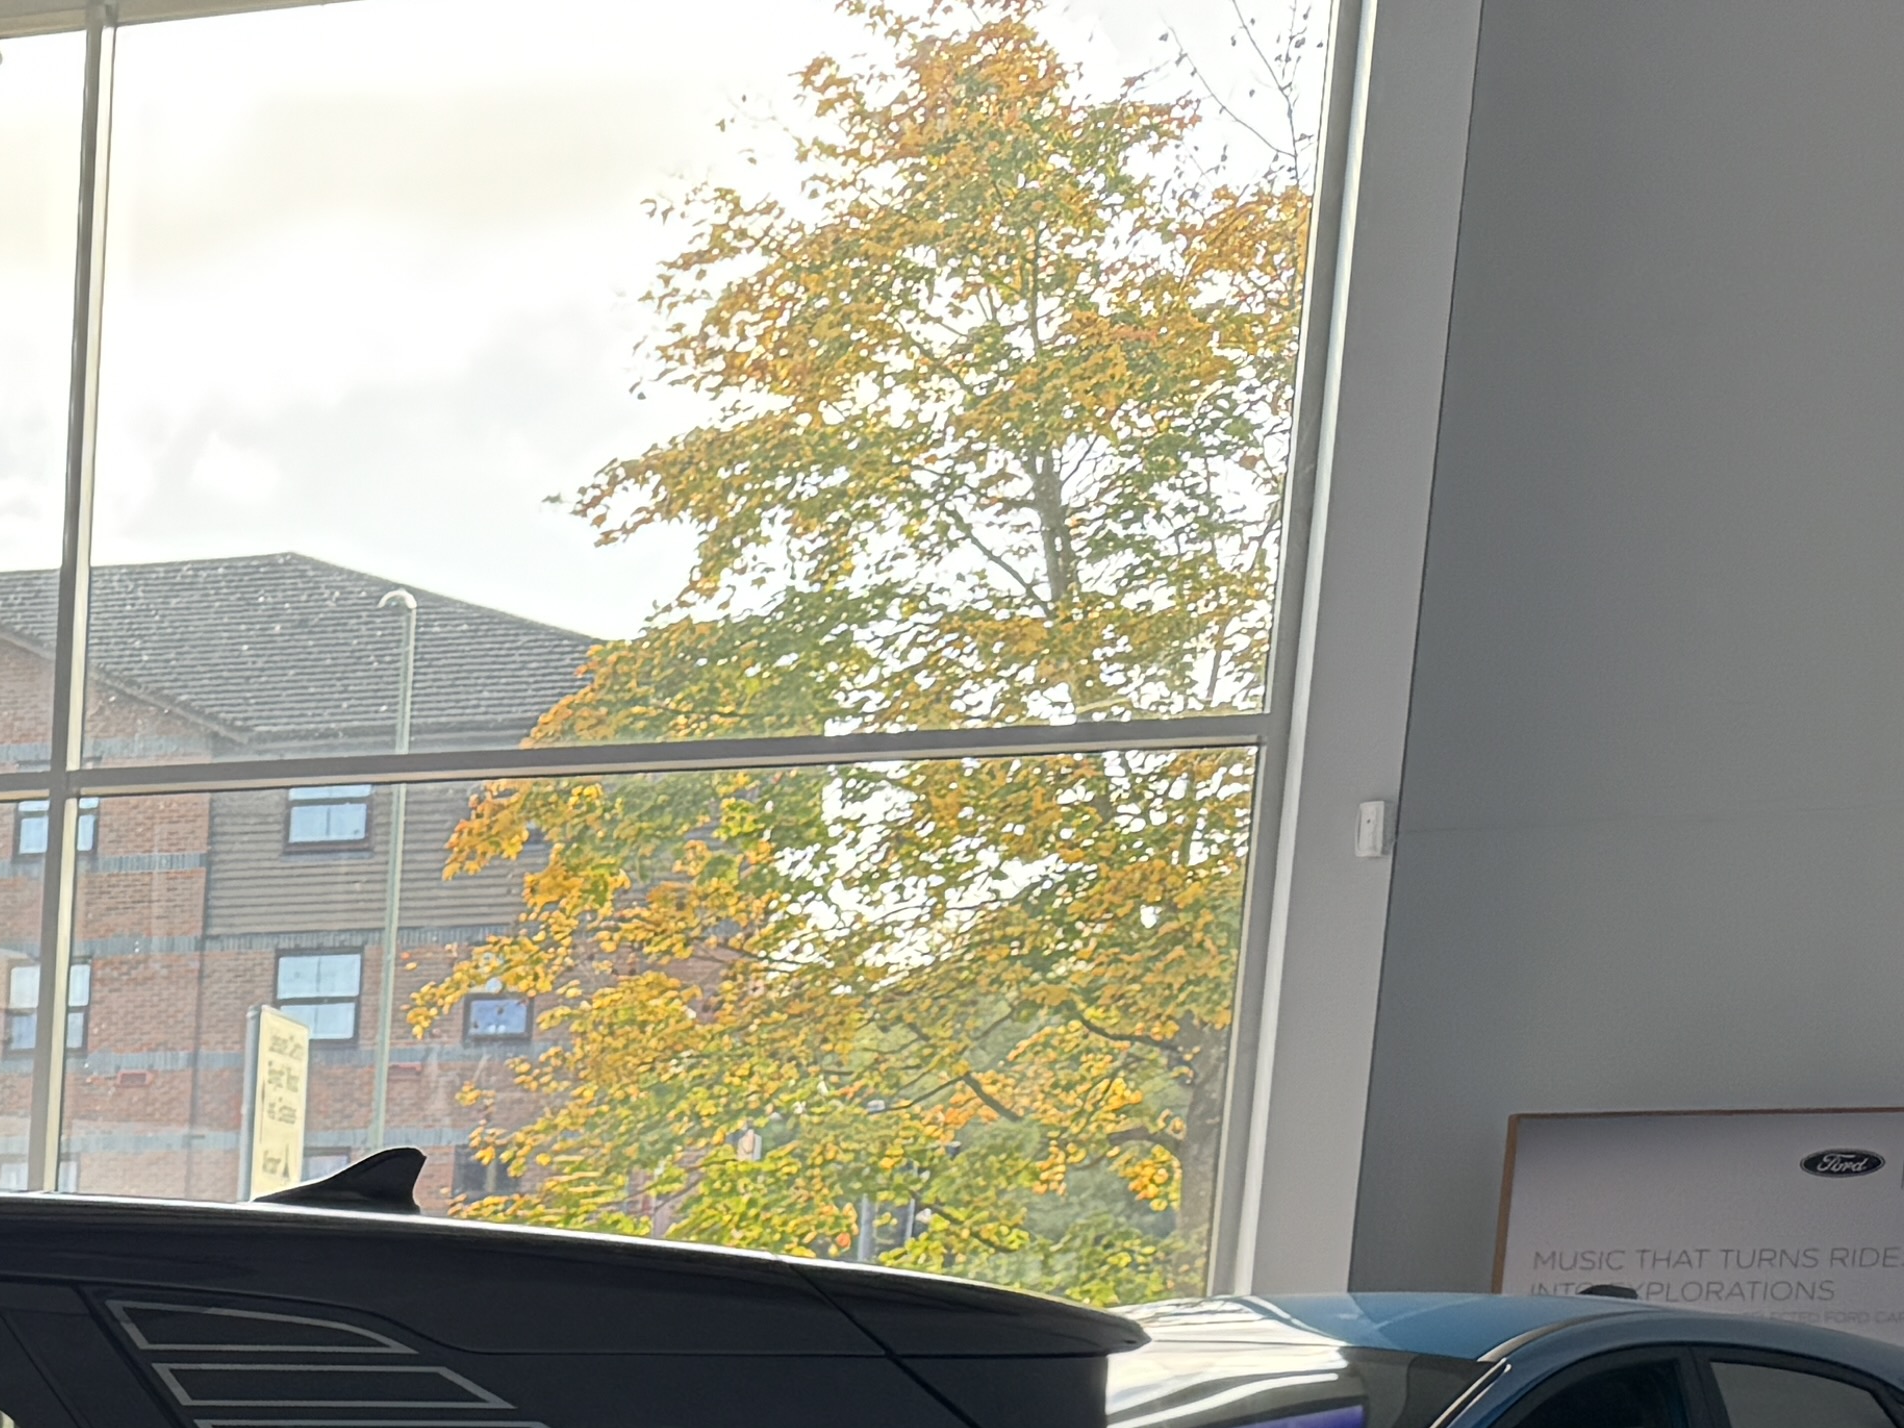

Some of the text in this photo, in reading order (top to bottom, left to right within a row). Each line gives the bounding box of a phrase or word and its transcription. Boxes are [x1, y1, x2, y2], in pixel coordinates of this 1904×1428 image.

[1816, 1153, 1869, 1172] Ford
[1533, 1246, 1904, 1272] MUSIC THAT TURNS RIDE
[1610, 1280, 1835, 1302] PLORATIONS
